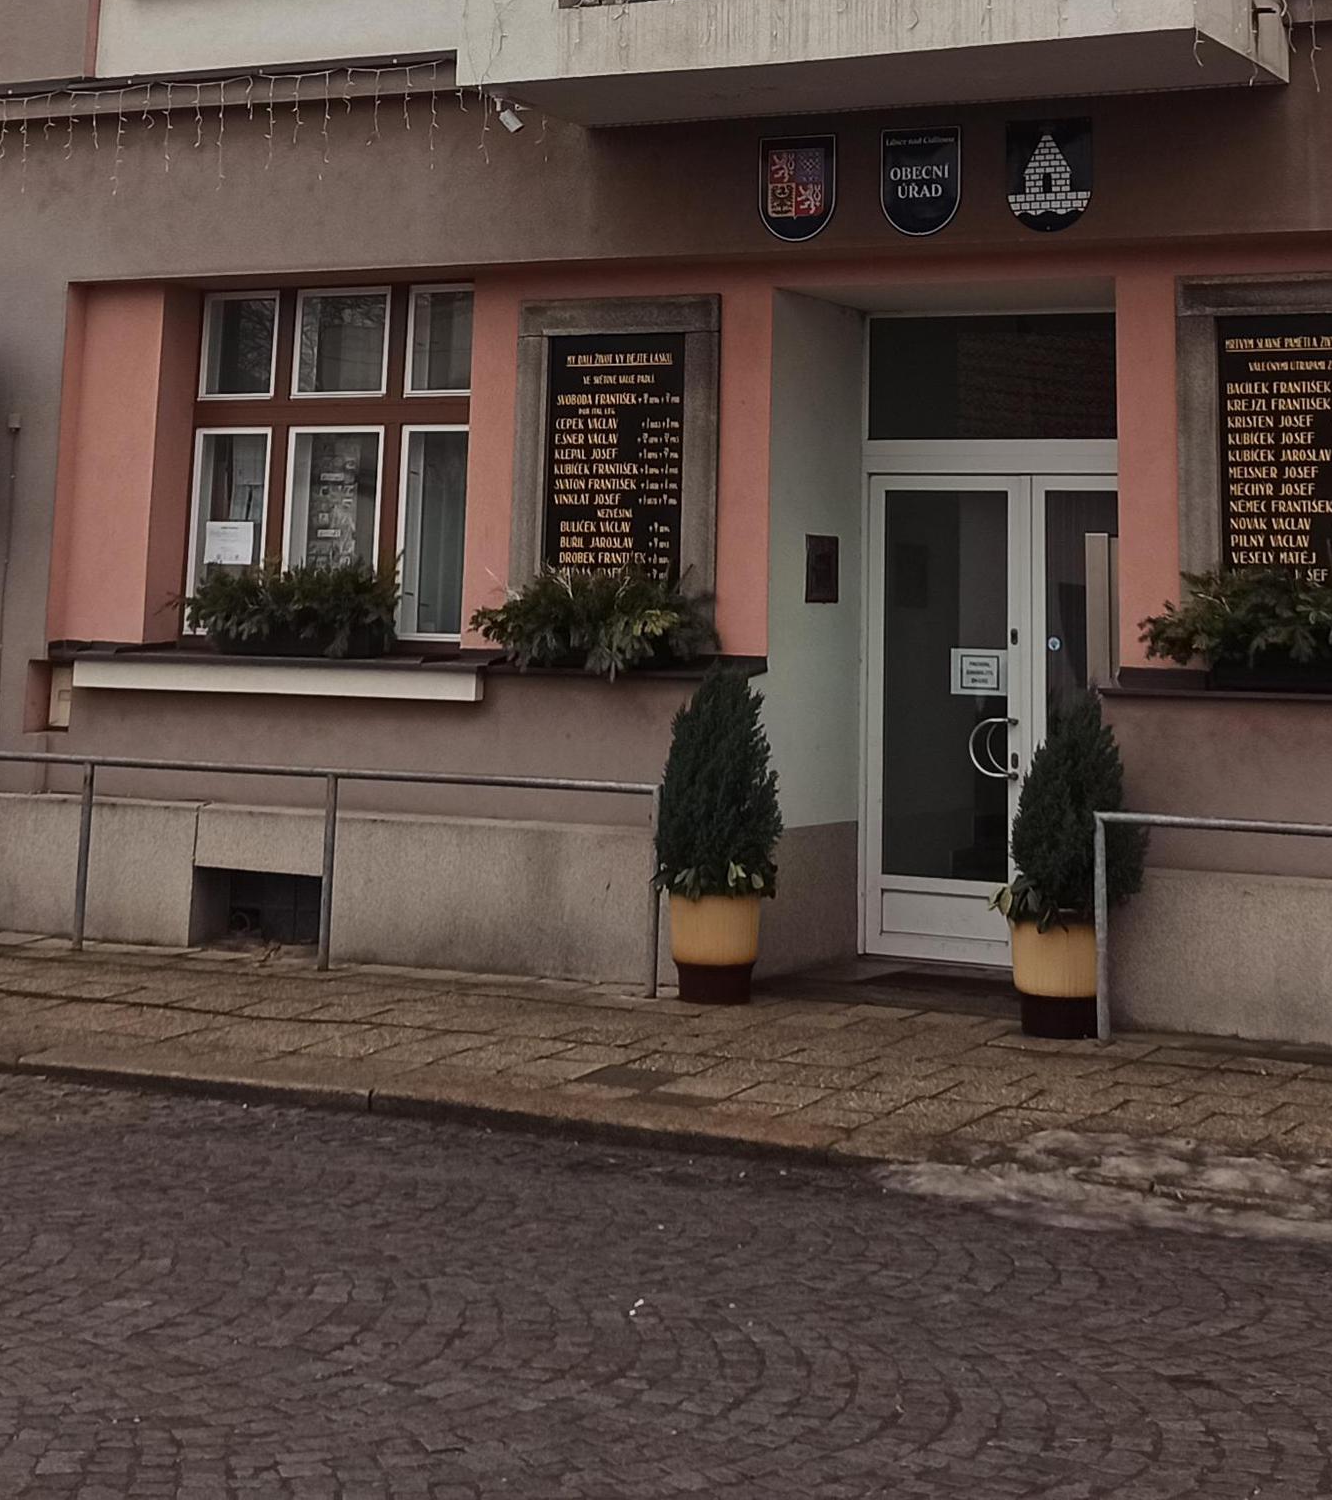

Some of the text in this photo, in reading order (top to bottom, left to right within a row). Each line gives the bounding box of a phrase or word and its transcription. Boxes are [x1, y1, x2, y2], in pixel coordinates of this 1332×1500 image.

[890, 163, 949, 181] OBECNÍ
[897, 182, 943, 199] ÚŘAD
[557, 394, 592, 405] SVOBODA
[1278, 414, 1314, 428] JOSEF
[1279, 431, 1315, 445] JOSEF
[590, 448, 619, 460] JOSEF
[1279, 448, 1332, 462] JAROSLAV
[1283, 465, 1319, 479] JOSEF
[1279, 483, 1316, 496] JOSEF
[593, 493, 622, 505] JOSEF
[1229, 499, 1268, 513] NĚMEC
[589, 536, 634, 549] JAROSLAV
[559, 551, 595, 564] DROBEK
